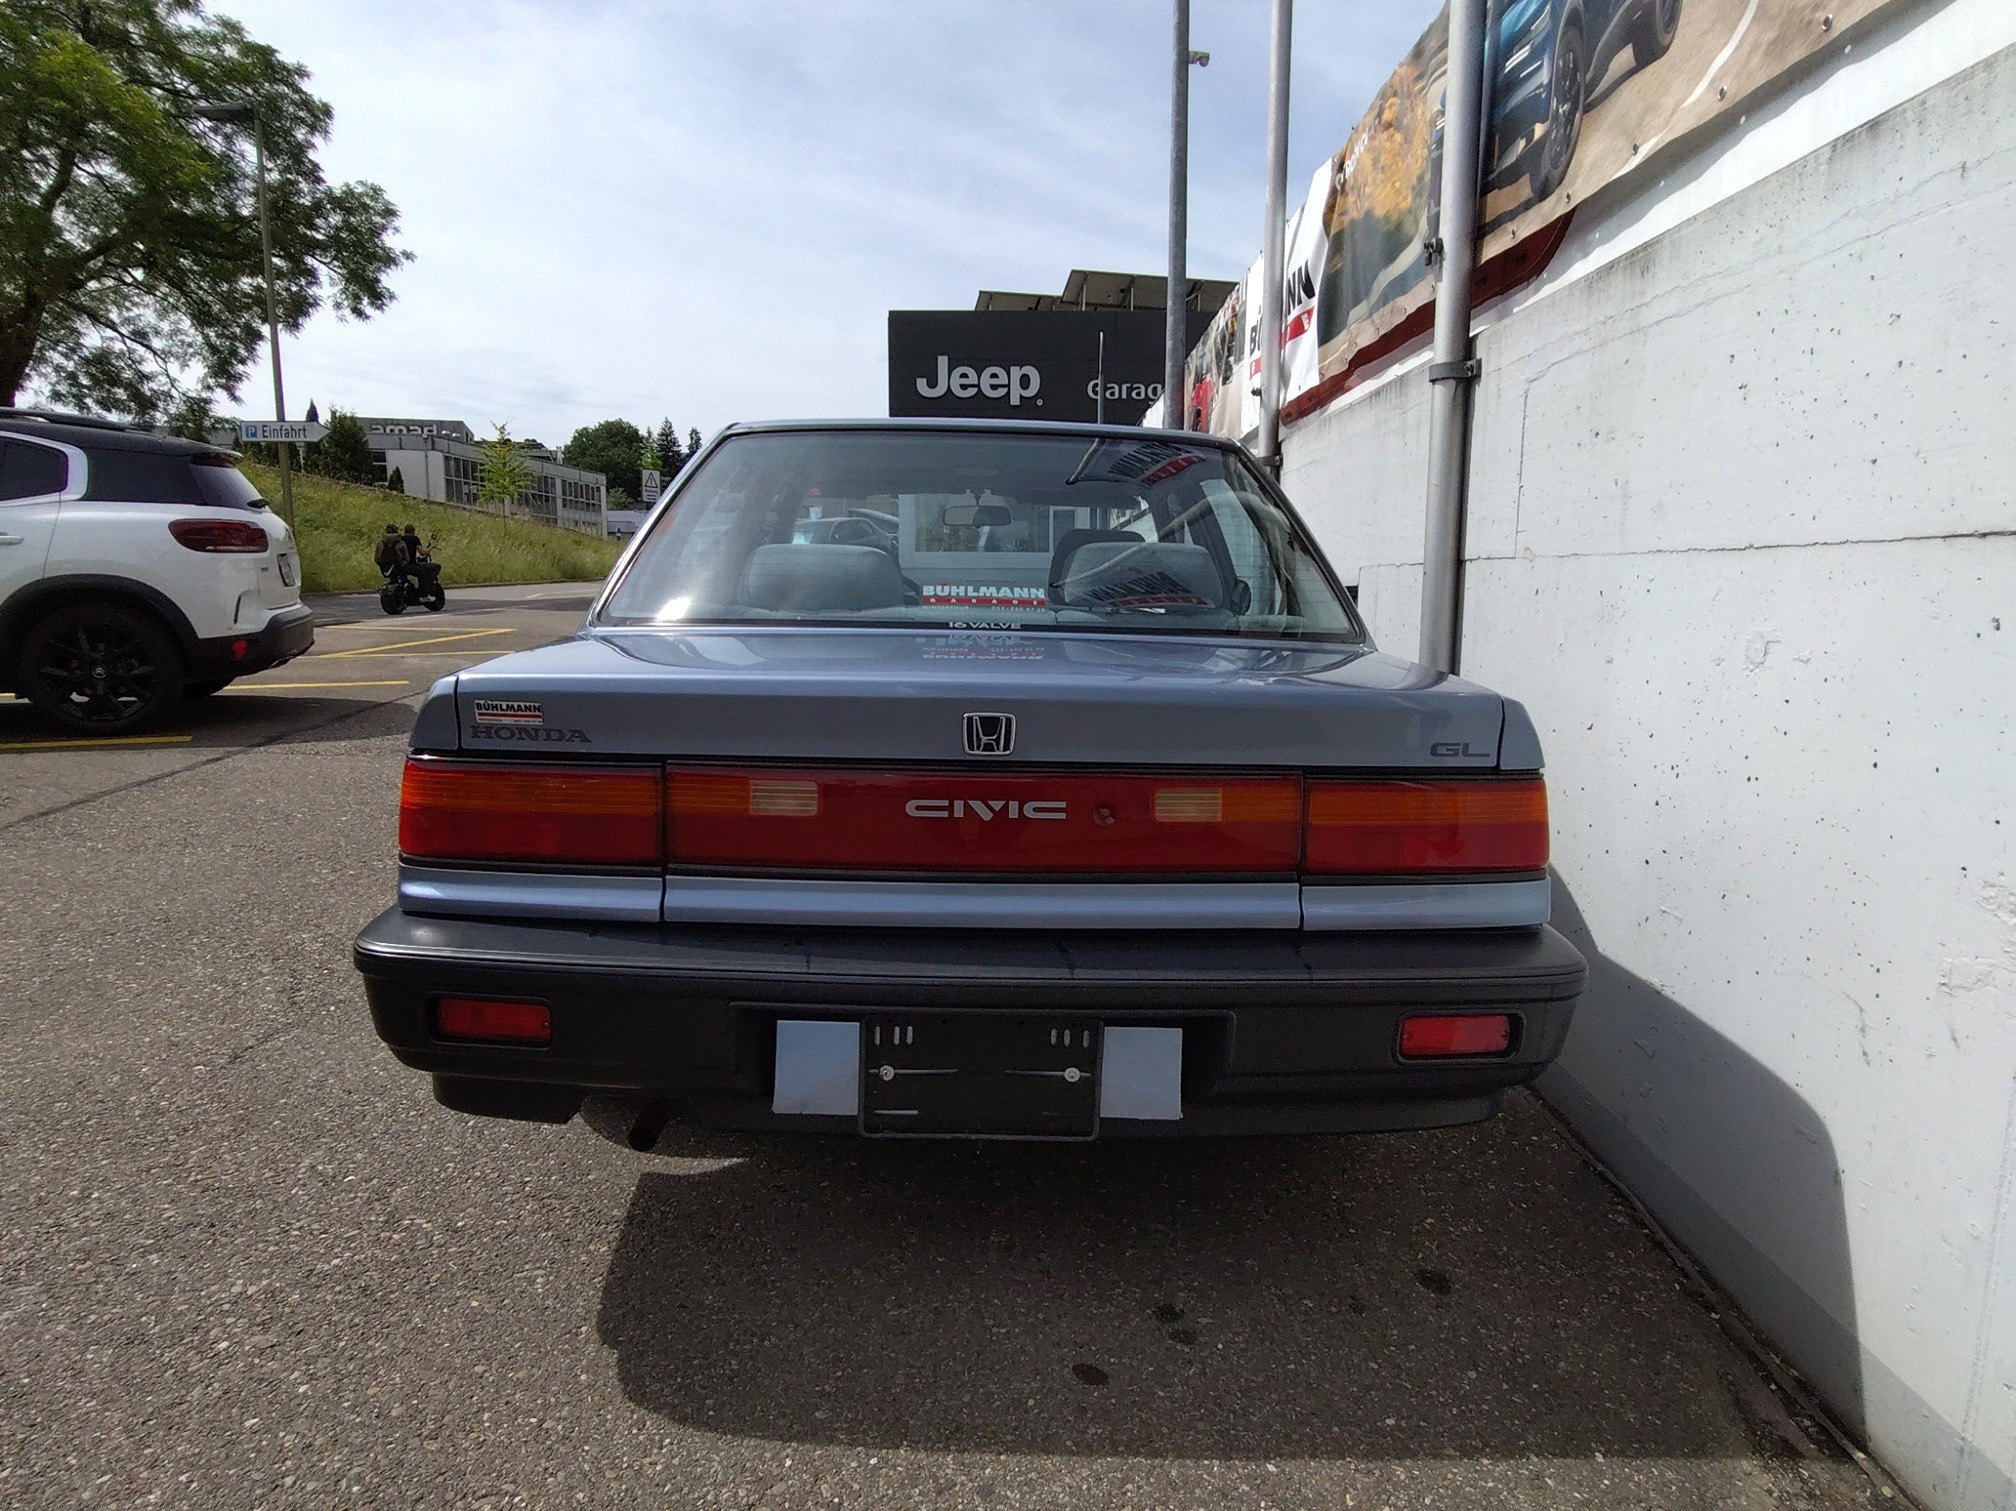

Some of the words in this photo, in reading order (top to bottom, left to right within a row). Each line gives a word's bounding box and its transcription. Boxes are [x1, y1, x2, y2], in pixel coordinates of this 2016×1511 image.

[916, 355, 1041, 406] Jeep
[1086, 379, 1167, 406] Garag
[261, 424, 307, 439] Einfahrt
[968, 622, 1022, 630] VALVE
[475, 700, 542, 713] BÜHLMANN
[470, 725, 592, 744] HONDA
[1430, 742, 1491, 758] GL
[905, 799, 1067, 821] CIVIC
